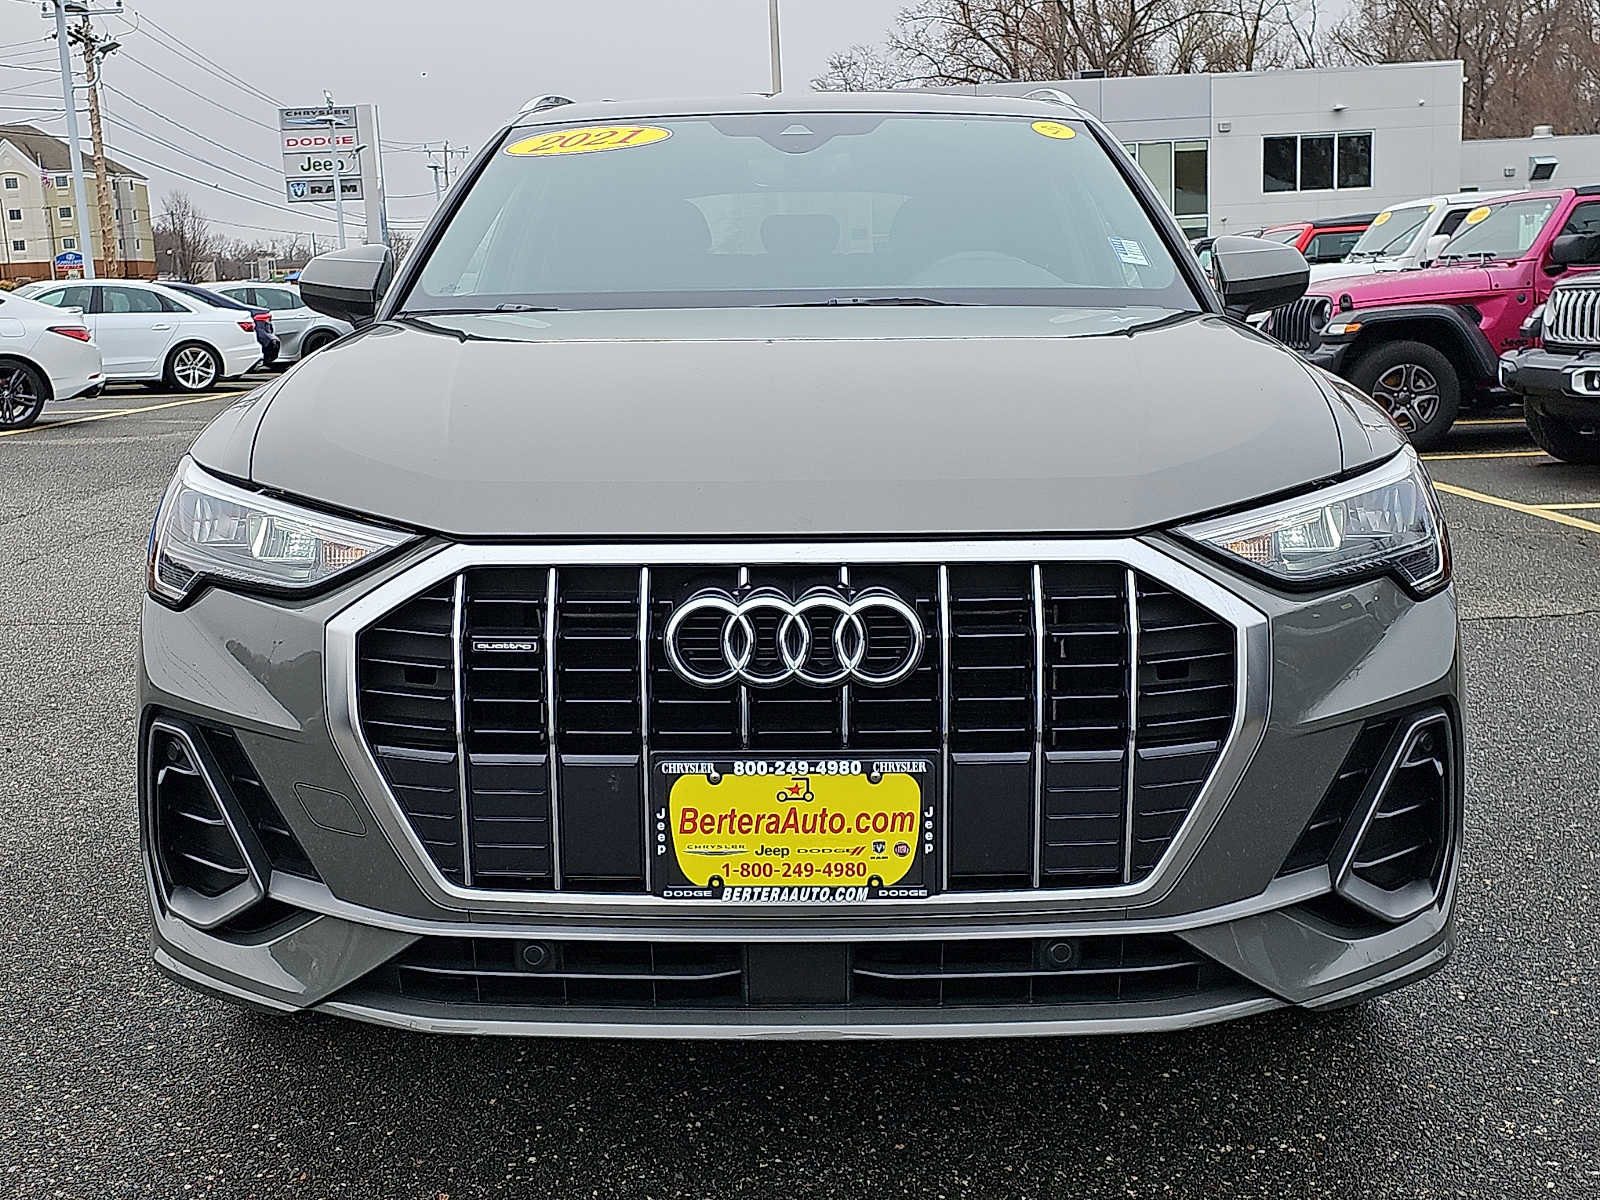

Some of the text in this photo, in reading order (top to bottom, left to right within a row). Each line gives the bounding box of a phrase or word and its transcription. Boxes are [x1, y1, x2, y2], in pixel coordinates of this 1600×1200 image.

[284, 109, 350, 117] CHRYSLER
[286, 135, 354, 147] DODGE
[528, 129, 645, 152] 2021
[310, 184, 358, 194] RAM
[661, 762, 715, 774] CHRYSLER
[872, 761, 928, 773] CHRYSLER
[679, 807, 916, 835] BerteraAuto.com
[656, 807, 667, 856] Jeep
[924, 806, 934, 855] Jeep
[754, 844, 790, 858] Jeep
[721, 862, 867, 878] 1-800-249-4980
[721, 886, 869, 902] BERTERAAUTO.COM
[878, 889, 928, 897] DODGE
